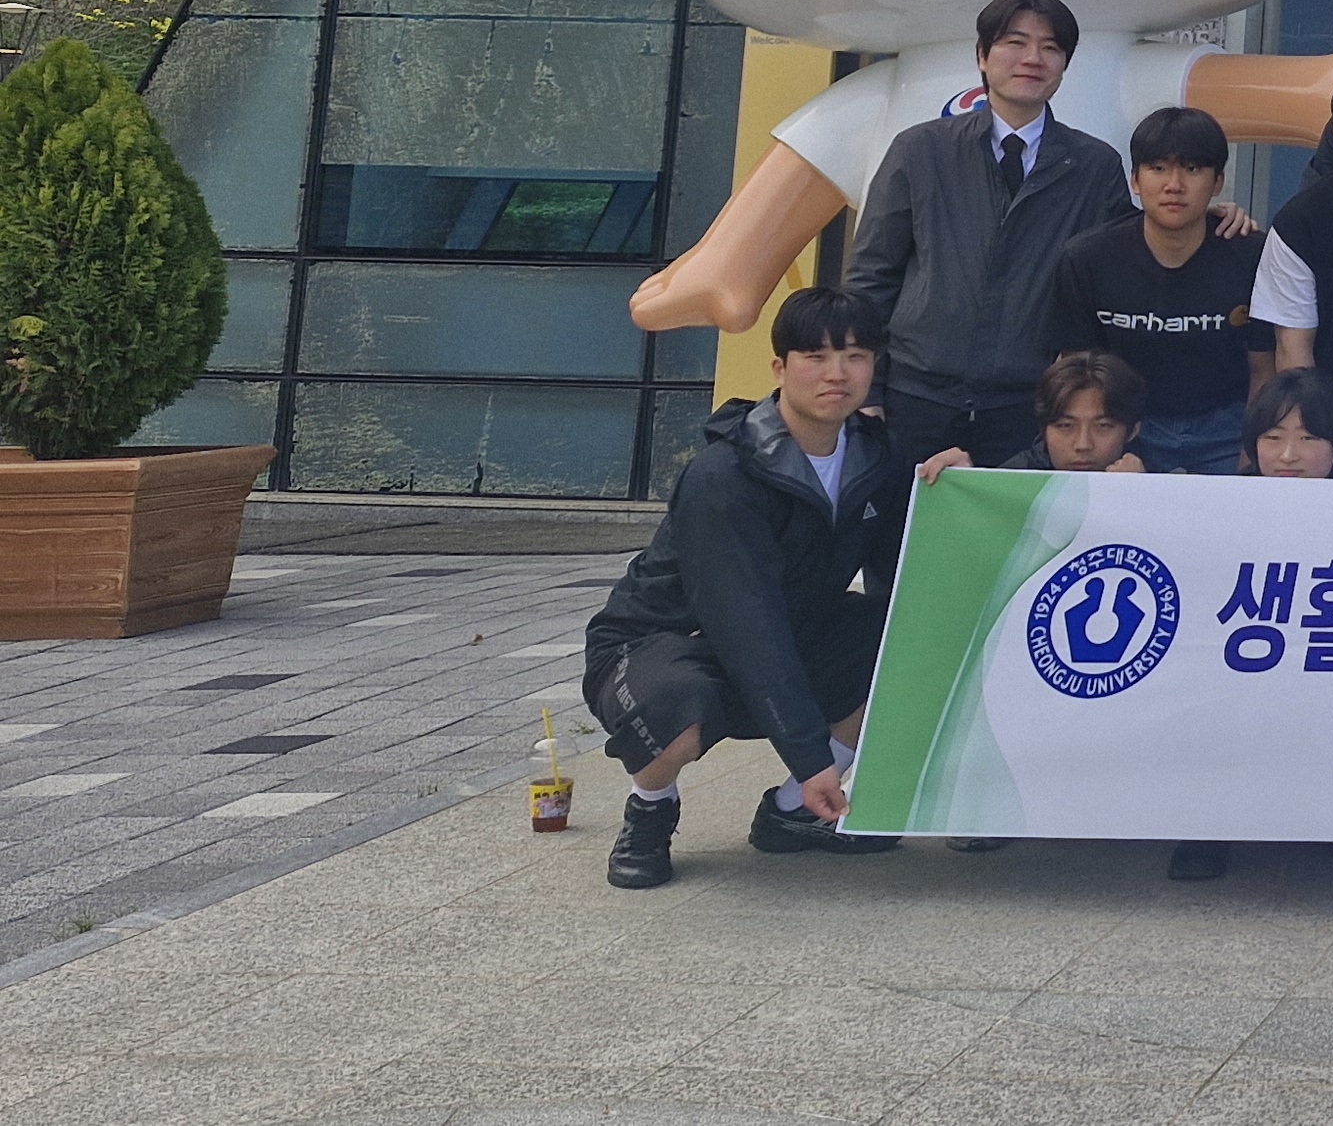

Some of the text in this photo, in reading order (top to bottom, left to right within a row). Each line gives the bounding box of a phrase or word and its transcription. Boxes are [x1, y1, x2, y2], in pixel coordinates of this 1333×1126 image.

[1097, 311, 1225, 332] carhartt
[1068, 546, 1161, 580] 청주대학교
[1033, 582, 1062, 621] 1924
[1157, 584, 1175, 622] 1947
[1030, 626, 1172, 696] CHEONGJU UNIVERSITY
